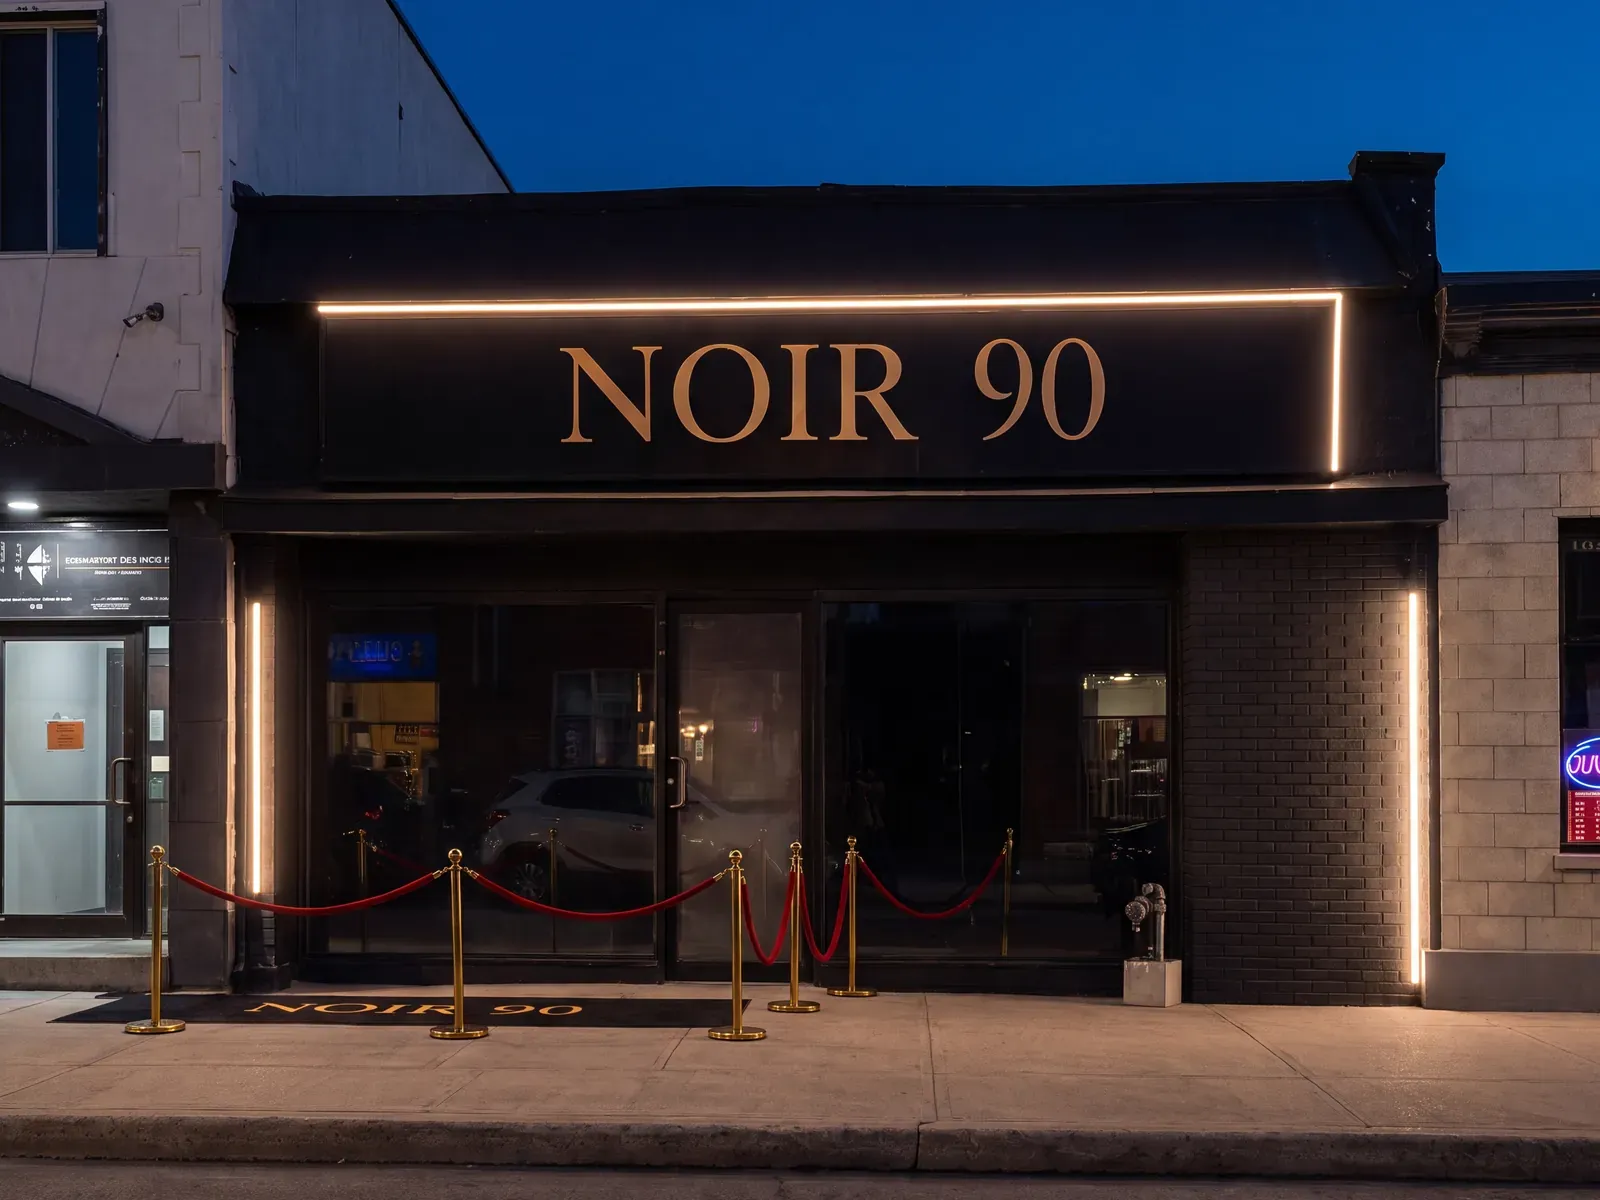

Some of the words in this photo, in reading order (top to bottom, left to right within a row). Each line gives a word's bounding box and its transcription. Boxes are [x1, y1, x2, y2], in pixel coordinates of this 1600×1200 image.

[559, 343, 919, 443] NOIR
[974, 338, 1106, 441] 90
[120, 556, 137, 564] DES
[243, 1001, 455, 1015] NOIR
[489, 1004, 584, 1016] 90
